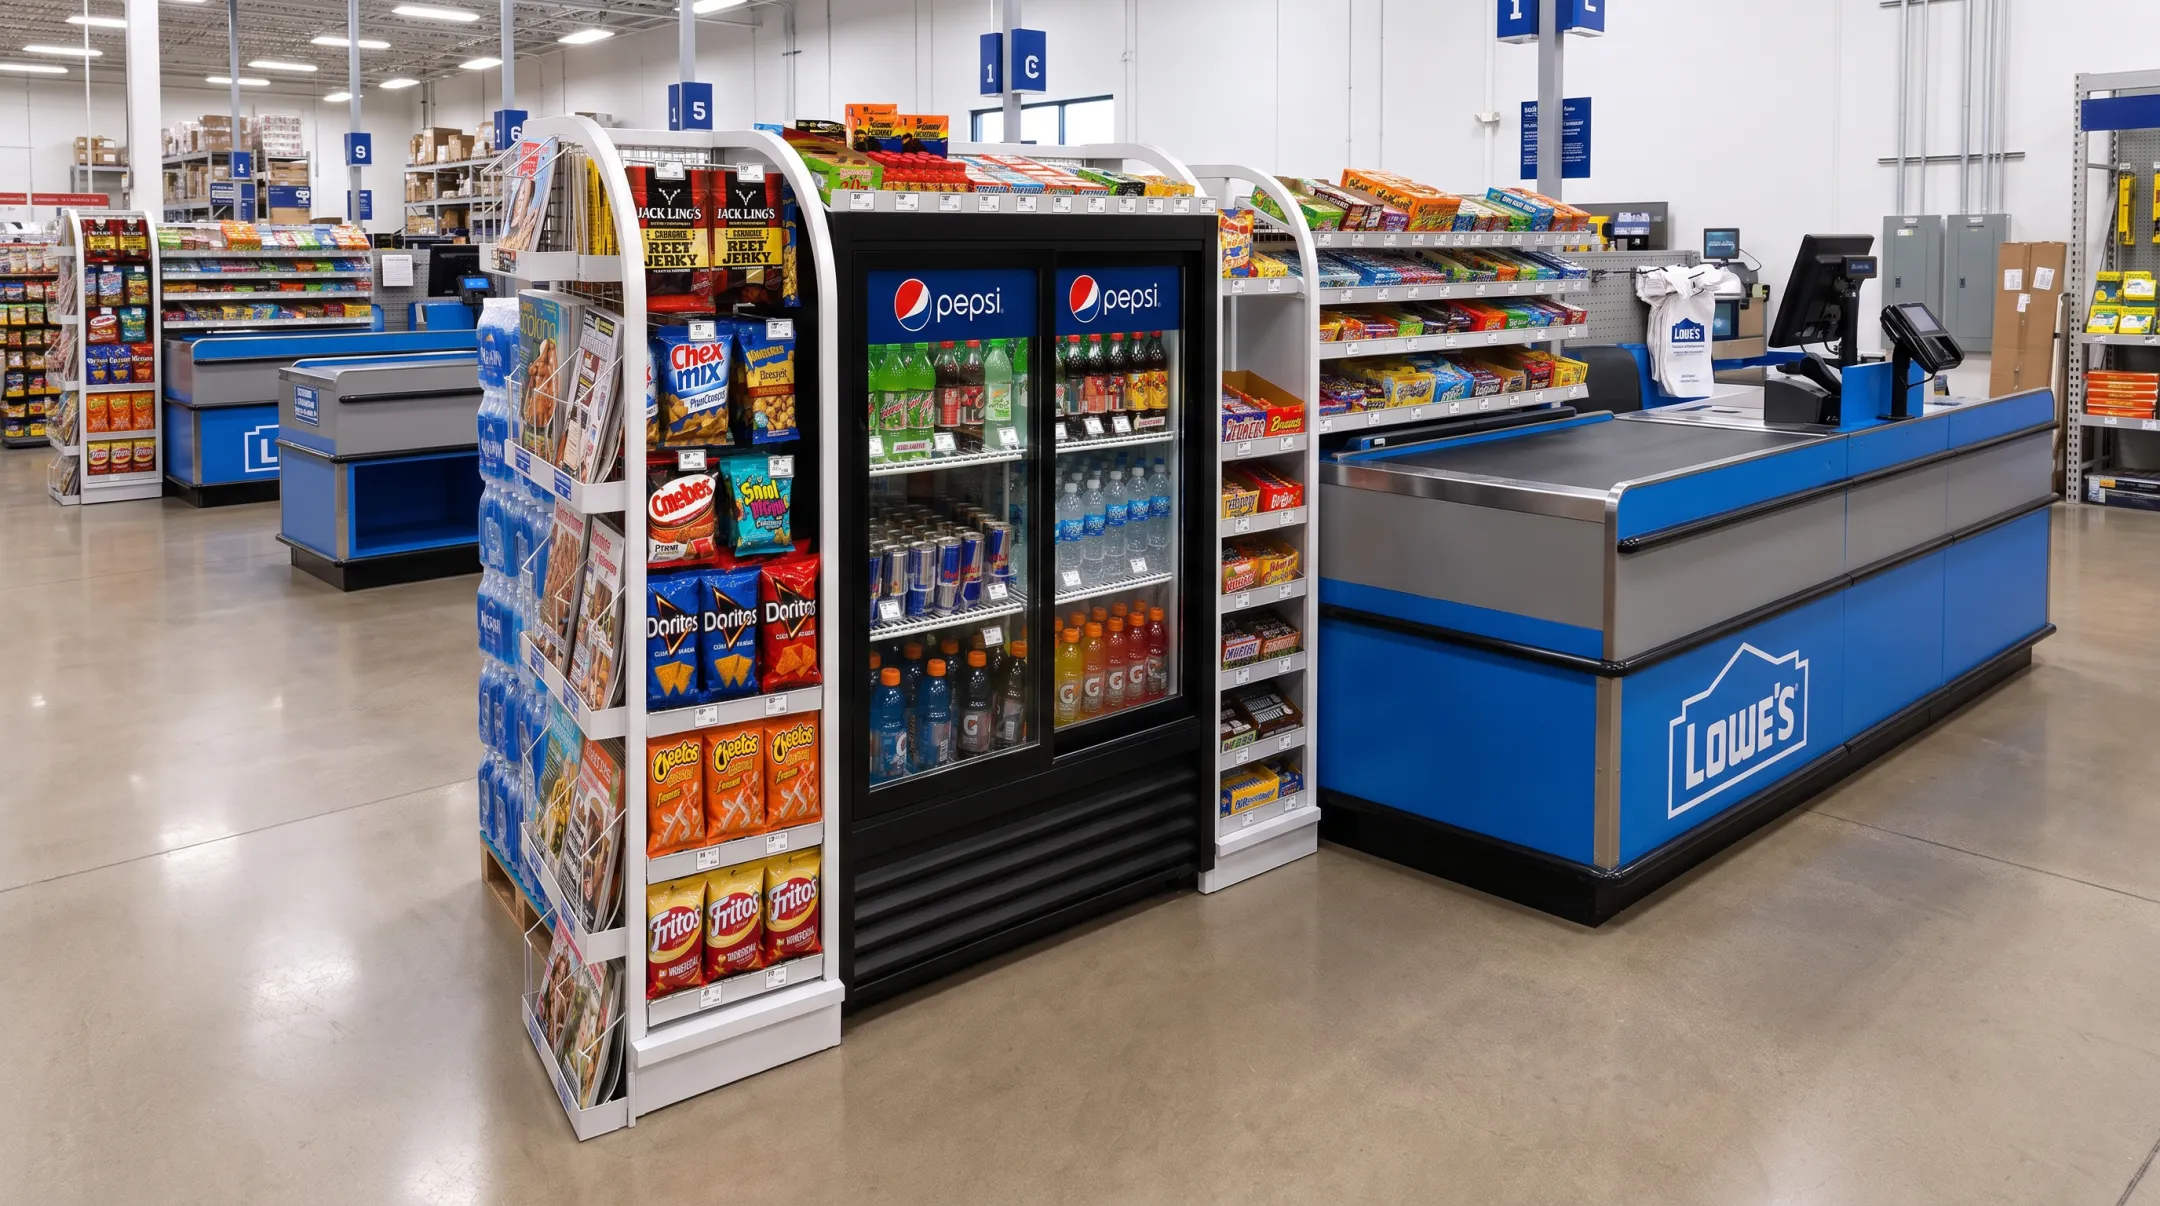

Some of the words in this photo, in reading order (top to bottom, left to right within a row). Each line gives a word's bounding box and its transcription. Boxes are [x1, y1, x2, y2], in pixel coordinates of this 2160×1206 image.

[986, 63, 994, 83] 1
[693, 101, 706, 121] 5
[495, 129, 501, 143] 1
[510, 126, 522, 142] 6
[637, 207, 665, 219] JACK
[667, 207, 702, 220] LING'S
[744, 207, 775, 220] LING'S
[937, 286, 1001, 323] pepsi
[1104, 282, 1158, 315] pepsi
[671, 342, 724, 370] Chex
[704, 608, 758, 632] Doritos
[765, 599, 817, 623] Doritos
[647, 614, 699, 639] Doritos
[771, 723, 814, 764] Cheetos
[1685, 682, 1796, 791] LOWE'S
[652, 741, 700, 783] Cheetos
[713, 733, 759, 772] Cheetos
[767, 877, 818, 923] Fritos
[708, 891, 759, 938] Fritos
[649, 905, 701, 954] Fritos
